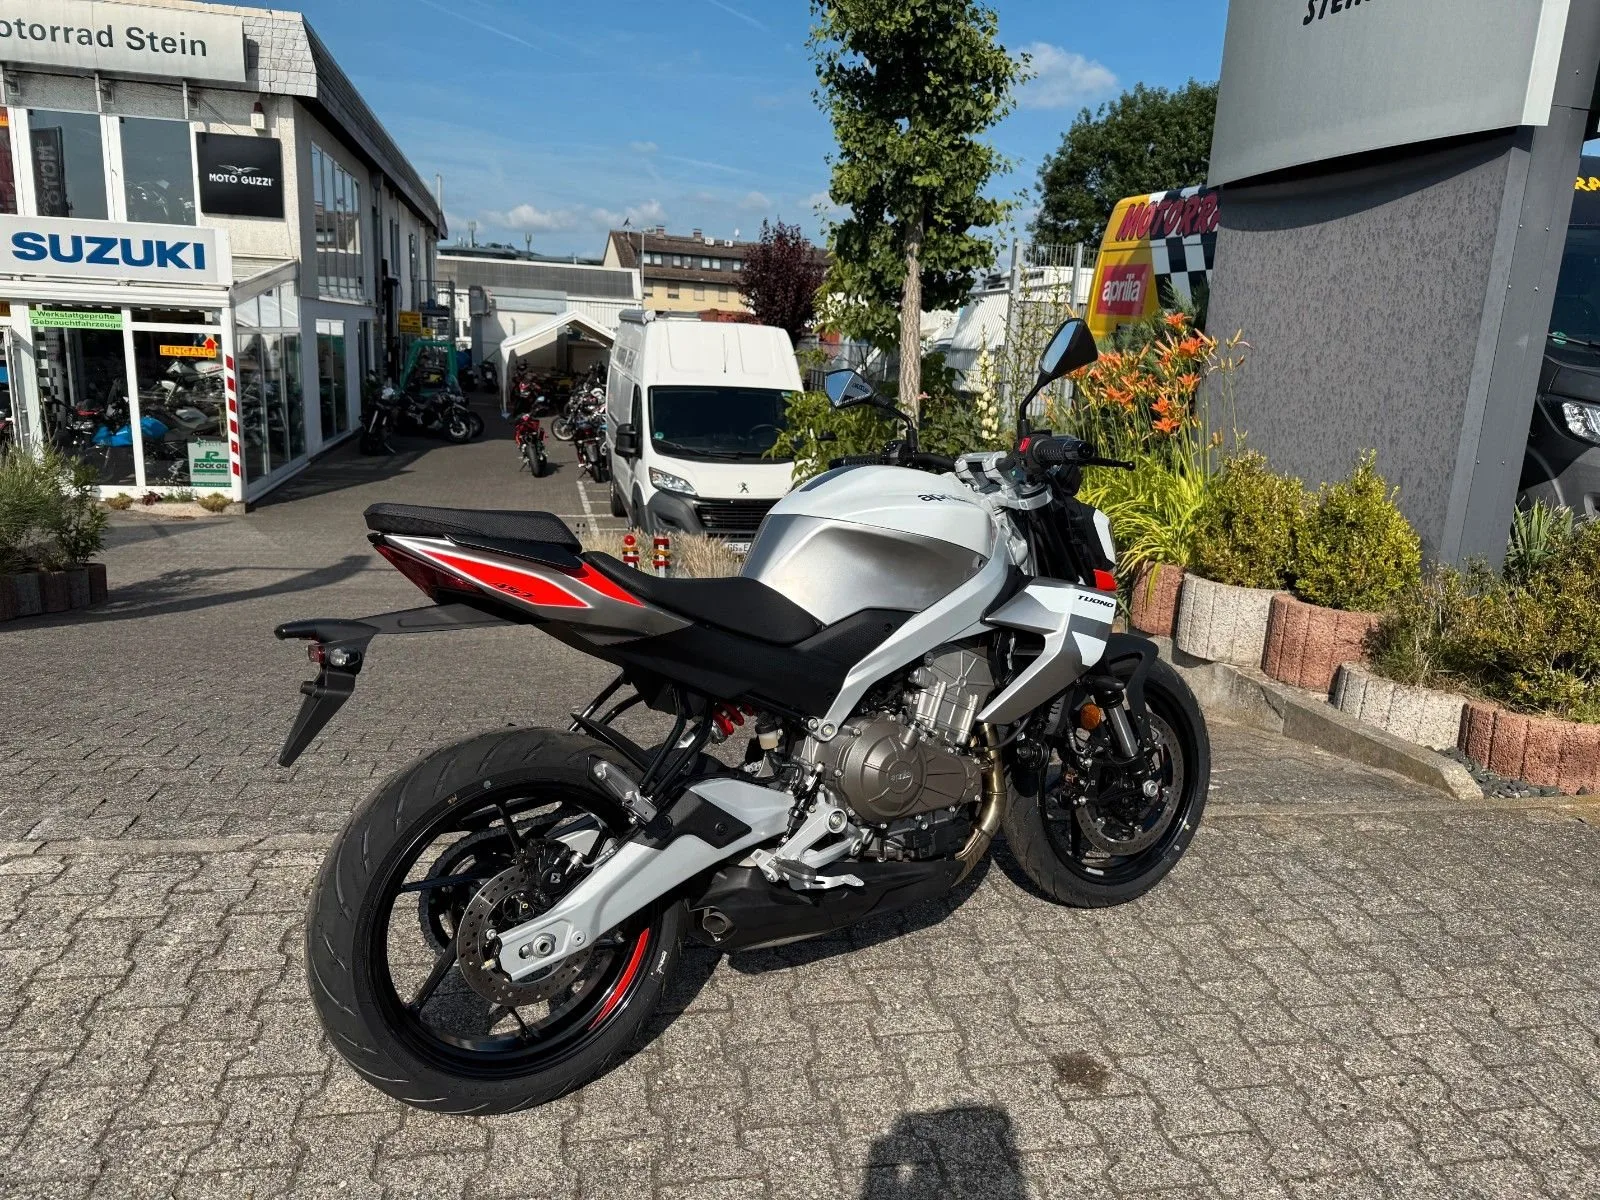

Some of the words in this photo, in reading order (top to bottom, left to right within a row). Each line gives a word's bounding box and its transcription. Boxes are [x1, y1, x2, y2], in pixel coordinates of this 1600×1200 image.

[125, 26, 207, 57] Stein
[208, 173, 238, 184] MOTO
[240, 175, 272, 187] GUZZI
[11, 231, 206, 270] SUZUKI
[1101, 273, 1141, 307] aprilia
[36, 310, 115, 320] Werkstattgeprüfte
[32, 318, 121, 328] Gebrauchtfahrzeuge
[161, 345, 214, 356] EINGANG
[1077, 595, 1114, 608] TUONO
